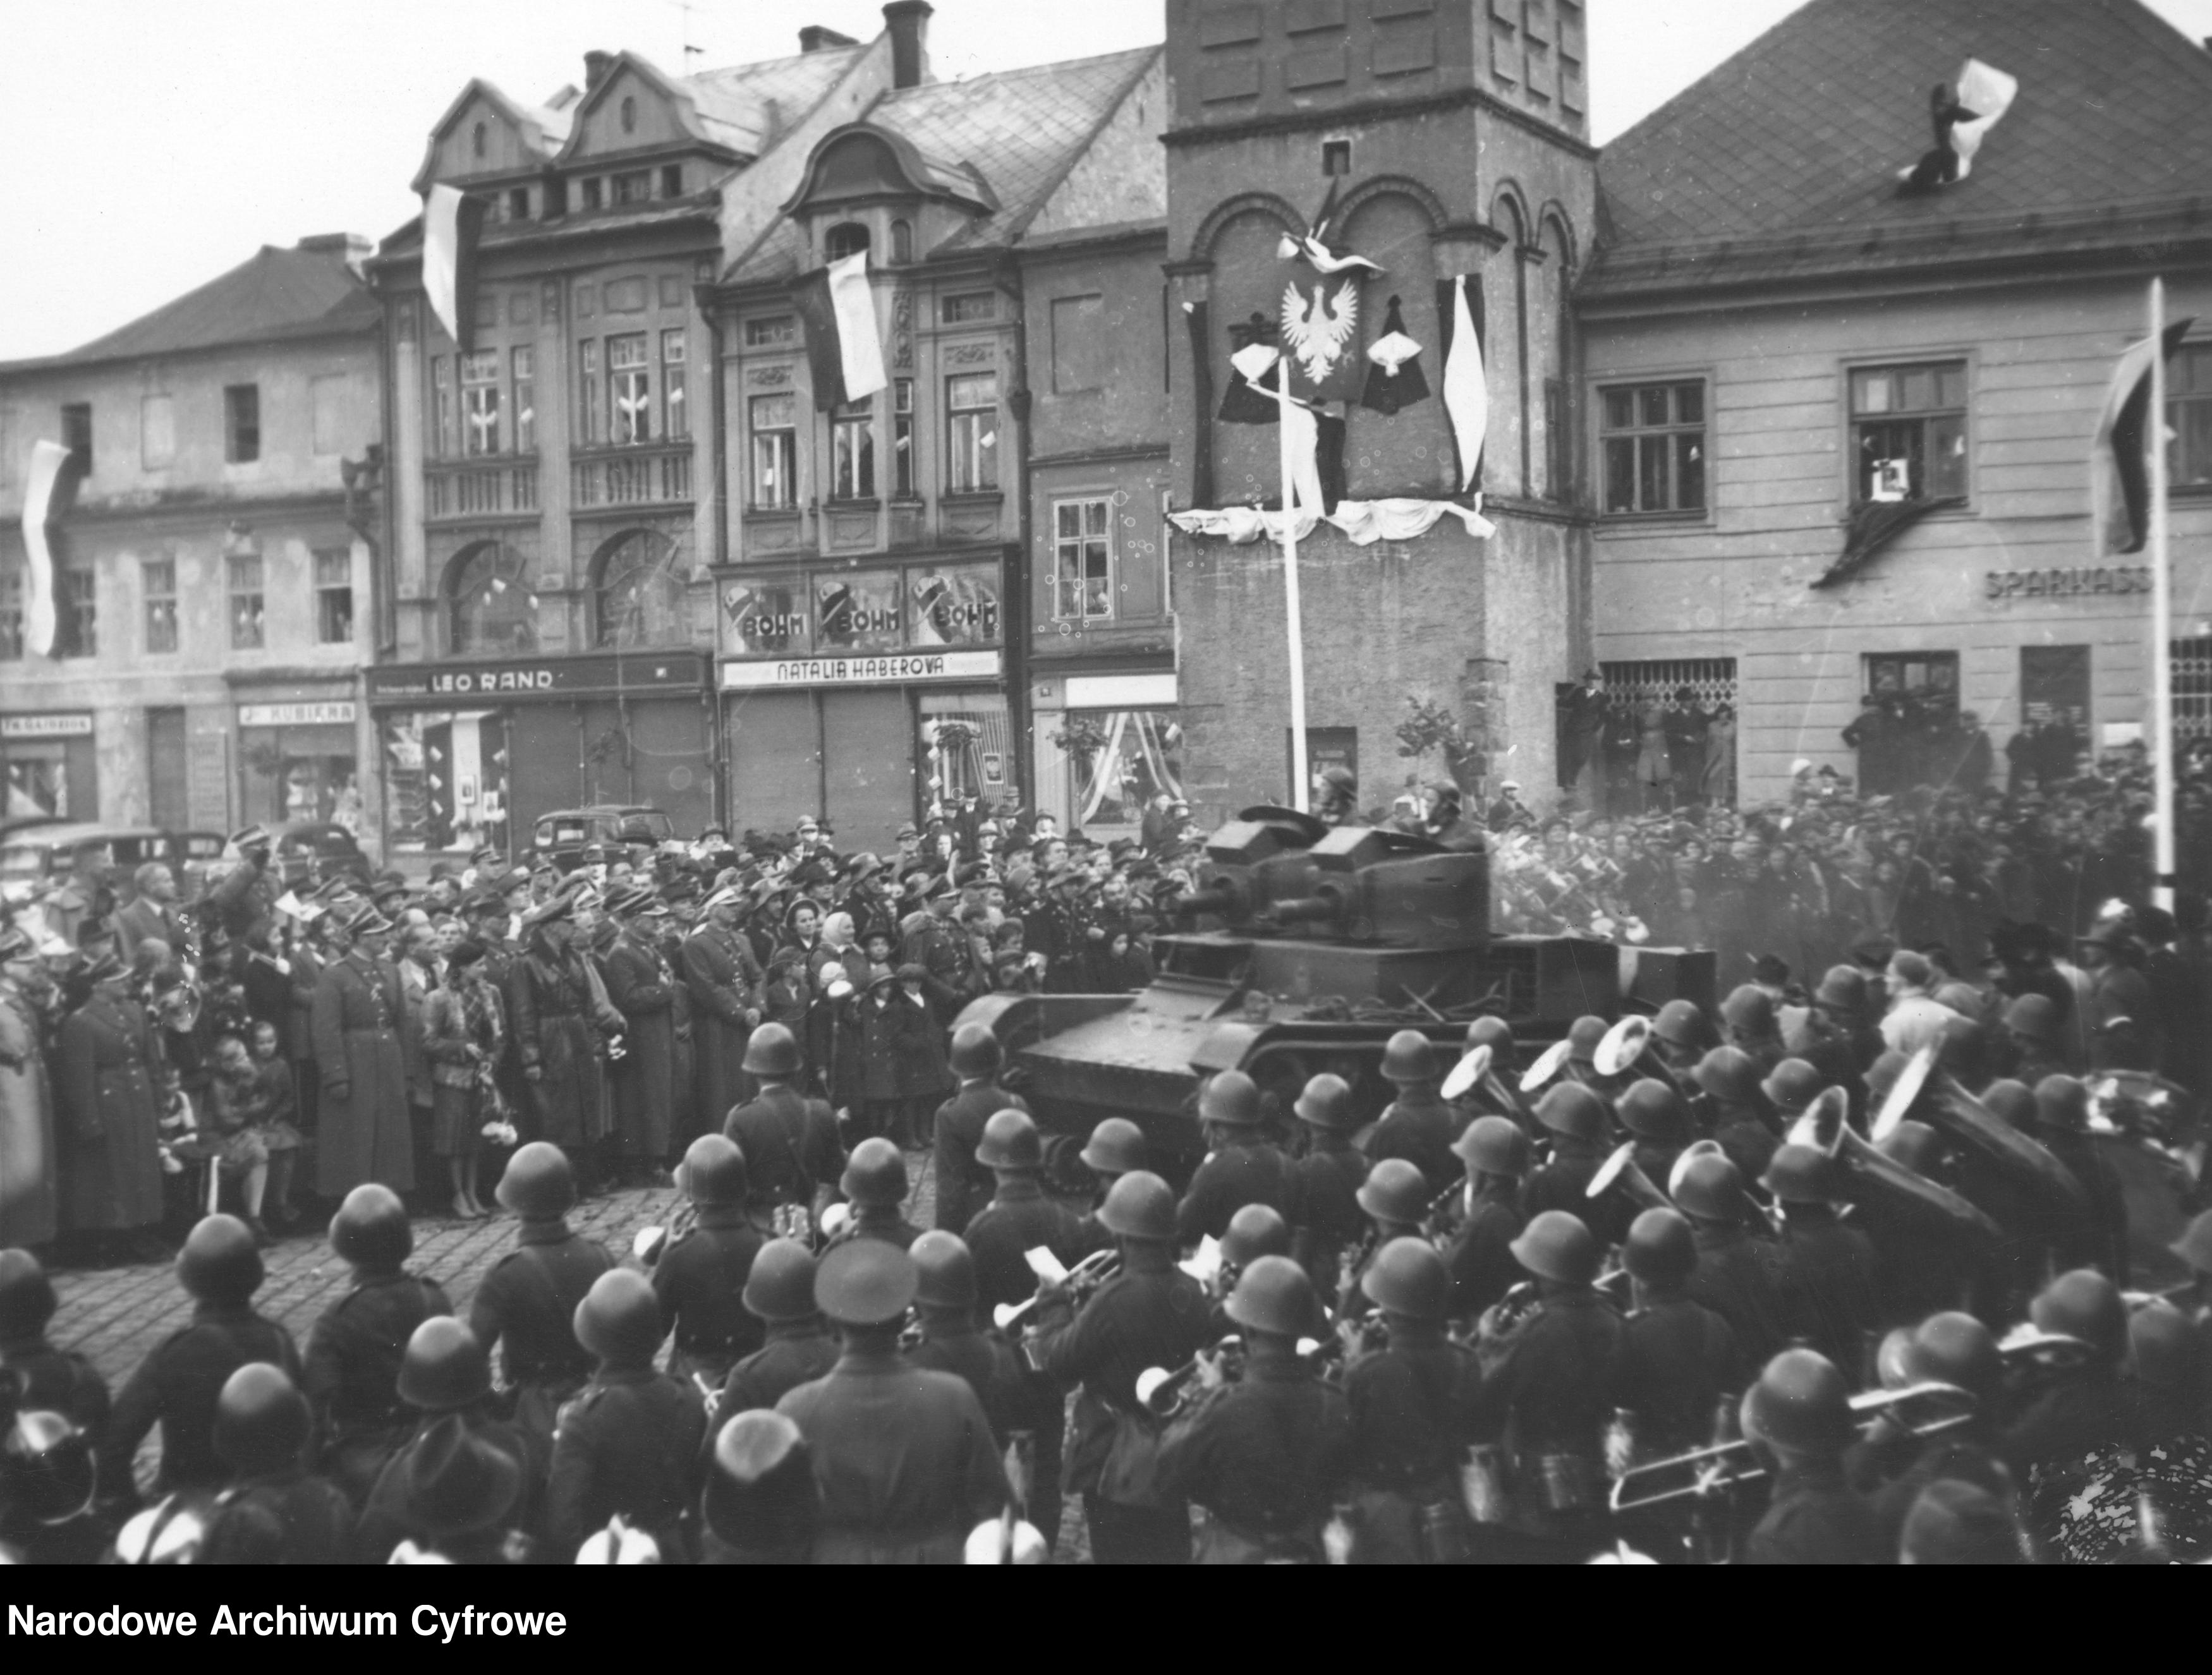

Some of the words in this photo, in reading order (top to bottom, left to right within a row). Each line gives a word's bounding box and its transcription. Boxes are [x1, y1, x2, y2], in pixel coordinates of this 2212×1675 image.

[1986, 564, 2175, 598] SPARKASS
[778, 660, 847, 680] NATALIA
[853, 657, 944, 677] HABEROVA
[432, 674, 472, 692] LEO
[480, 670, 553, 691] RAND
